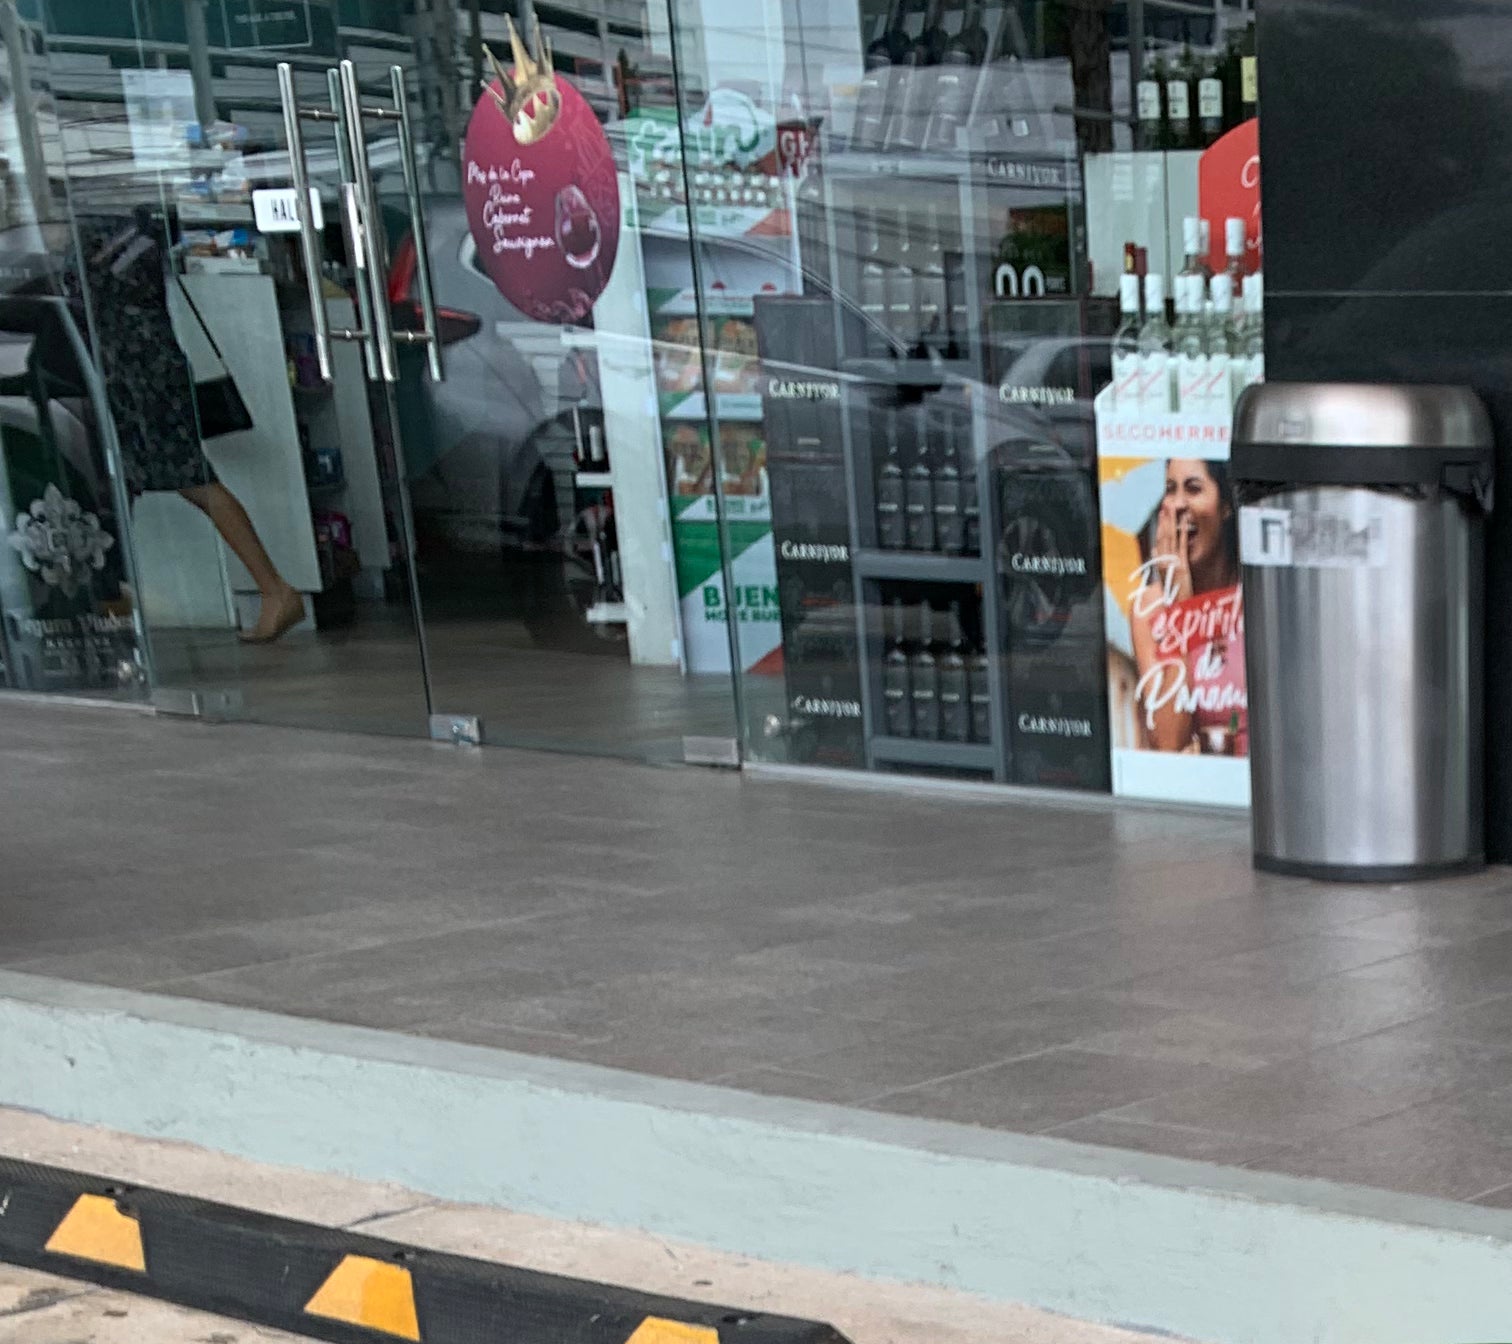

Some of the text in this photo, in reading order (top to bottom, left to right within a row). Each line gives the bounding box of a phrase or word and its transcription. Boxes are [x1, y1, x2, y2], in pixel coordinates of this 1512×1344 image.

[769, 378, 840, 401] CARNIVOR
[1000, 382, 1075, 405] CARNIVOR
[781, 539, 850, 563] CARNIVOR
[1011, 552, 1087, 576] CARNIVOR
[1128, 554, 1180, 617] El
[791, 695, 862, 718] CARNIVOR
[1018, 712, 1093, 737] CARNIVOR
